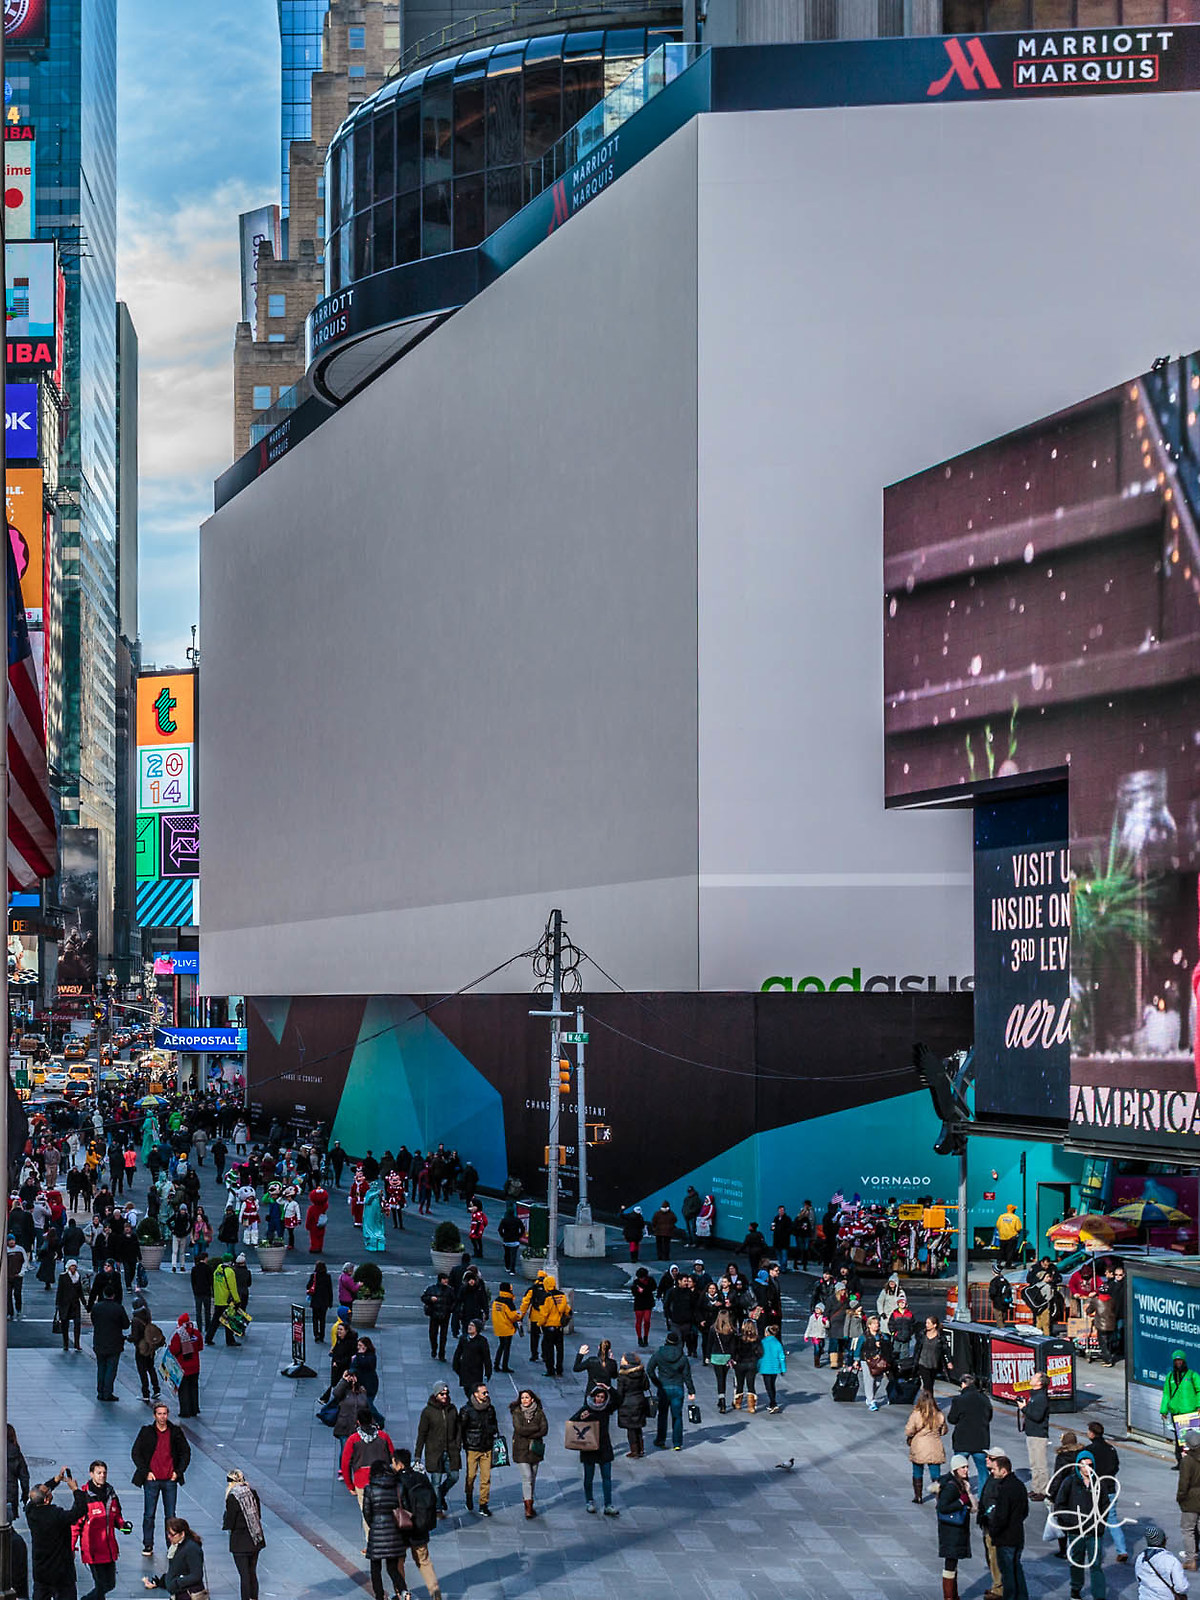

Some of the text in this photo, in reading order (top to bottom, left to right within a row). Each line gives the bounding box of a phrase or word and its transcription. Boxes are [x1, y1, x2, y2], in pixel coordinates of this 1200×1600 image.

[1018, 32, 1173, 56] MARRIOTT
[1018, 59, 1154, 83] MARQUIS
[572, 136, 621, 185] MARRIOTT
[572, 165, 614, 209] MARQUIS
[152, 688, 177, 736] t
[147, 753, 183, 778] 20
[150, 780, 181, 804] 14
[1012, 849, 1070, 888] VISIT U
[991, 892, 1070, 932] INSIDE ON
[1010, 939, 1035, 973] 3RD
[164, 1034, 242, 1045] AÉROPOSTALE
[574, 1034, 582, 1042] 46
[525, 1100, 606, 1117] CHANG COSTANT
[861, 1176, 931, 1185] VORNADO
[1135, 1294, 1184, 1317] "WINGING
[1140, 1314, 1146, 1324] IS
[1146, 1315, 1159, 1327] NOT
[1160, 1318, 1169, 1329] AN
[992, 1359, 1016, 1384] JERSEY
[1048, 1356, 1071, 1370] JERSEY
